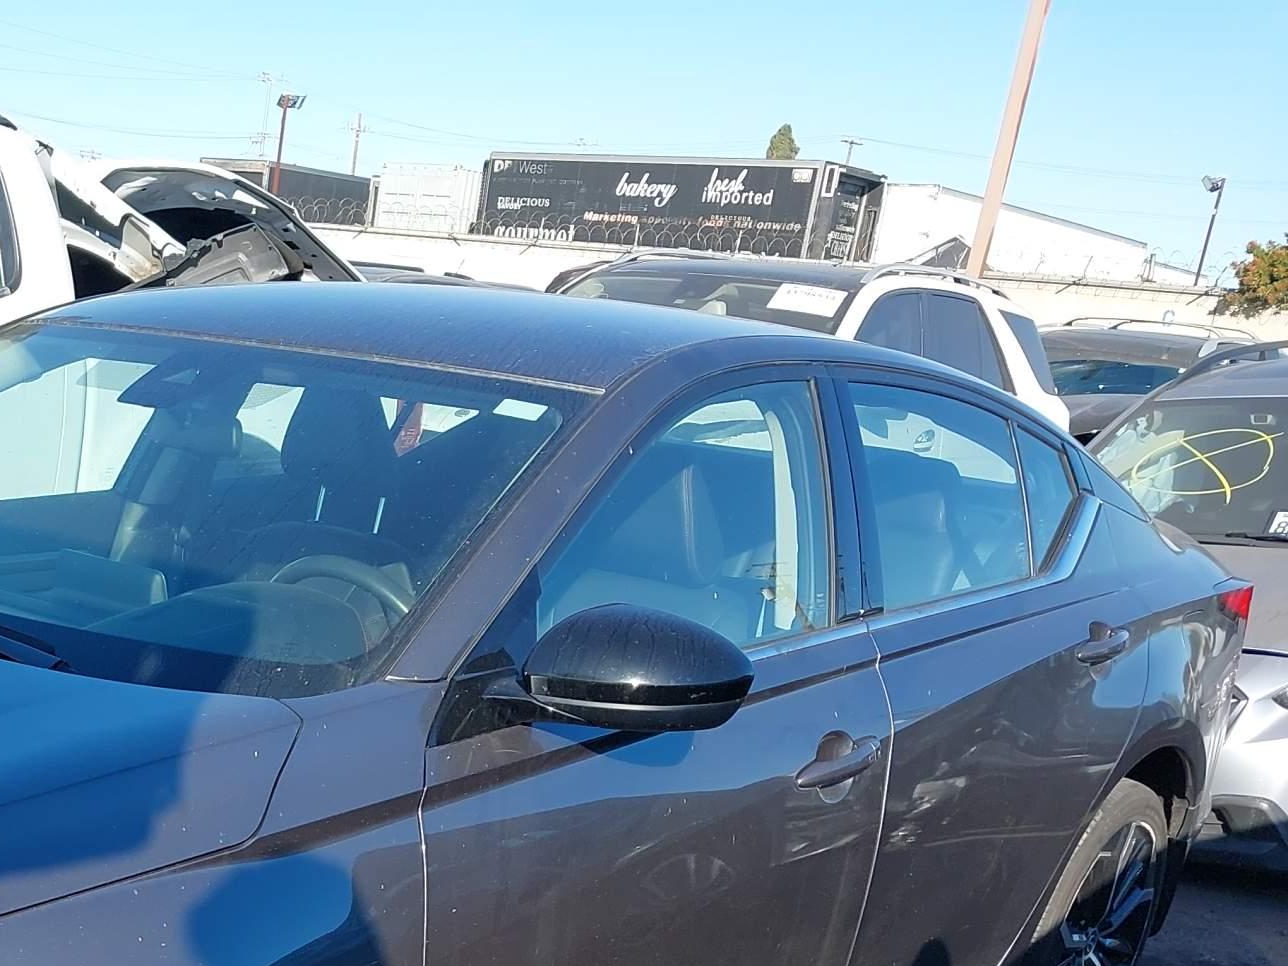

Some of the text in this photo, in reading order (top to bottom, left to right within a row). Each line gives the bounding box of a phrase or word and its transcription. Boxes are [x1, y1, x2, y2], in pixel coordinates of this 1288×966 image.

[519, 160, 548, 175] West
[616, 172, 678, 207] bakery
[701, 187, 773, 207] imported
[497, 196, 550, 208] DELICIOUS
[583, 211, 638, 225] Marketing
[733, 219, 801, 231] nationwide
[494, 224, 575, 241] gourmet
